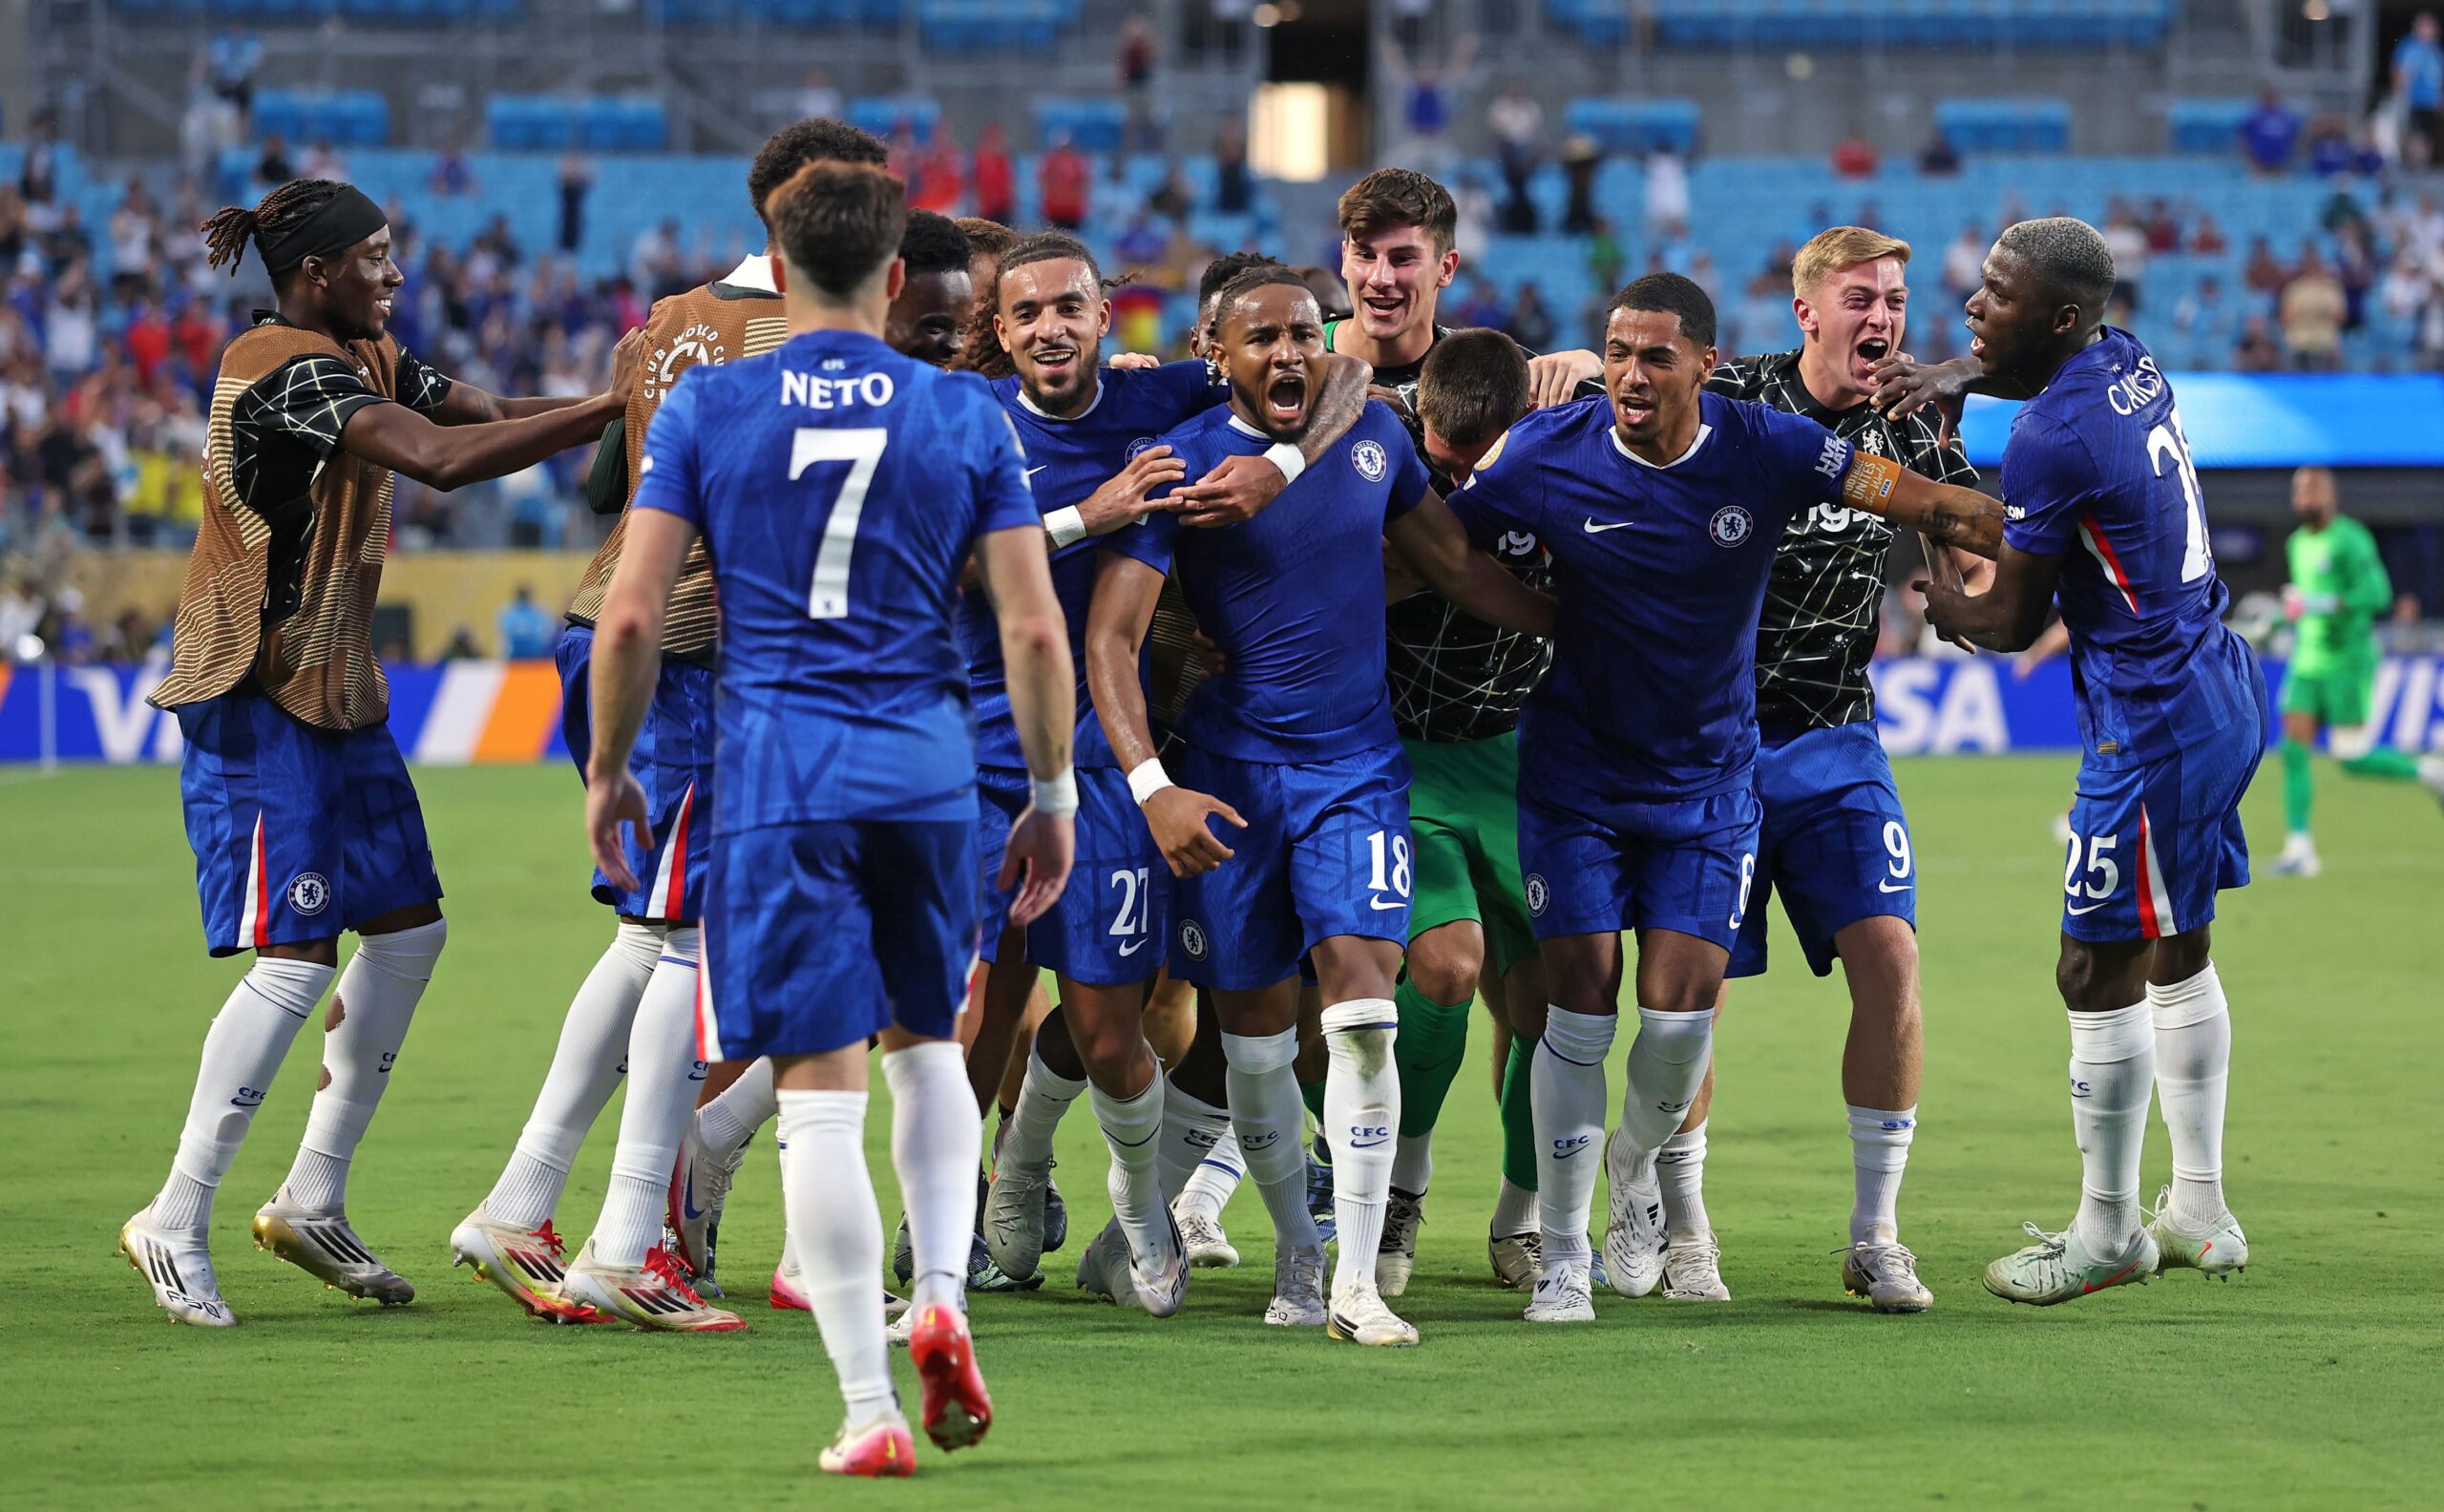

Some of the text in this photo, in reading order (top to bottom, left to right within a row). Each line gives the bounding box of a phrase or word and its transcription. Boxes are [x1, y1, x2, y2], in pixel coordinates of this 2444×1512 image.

[643, 324, 725, 400] CLUB WORLD CU
[780, 368, 895, 410] NETO
[1129, 439, 1152, 451] CHELS
[1814, 435, 1836, 473] LIVE
[1824, 438, 1847, 479] NATI
[1852, 462, 1876, 500] UNITES
[1880, 479, 1892, 496] FIFA
[788, 427, 889, 620] 7
[1717, 508, 1744, 518] CHELSEA
[2003, 505, 2026, 520] ON
[1876, 658, 2011, 756] SA
[1366, 830, 1411, 898] 18
[1883, 821, 1911, 879] 9
[2064, 830, 2119, 899] 25
[295, 874, 323, 884] CHELSEA
[1738, 852, 1756, 916] 6
[1108, 867, 1149, 935] 27
[382, 1052, 397, 1062] CF
[693, 1060, 710, 1071] CF
[2072, 1079, 2091, 1092] FC
[1242, 1130, 1280, 1144] CFC
[1351, 1126, 1389, 1137] CFC
[1553, 1135, 1591, 1149] CFC
[166, 1290, 221, 1319] F50
